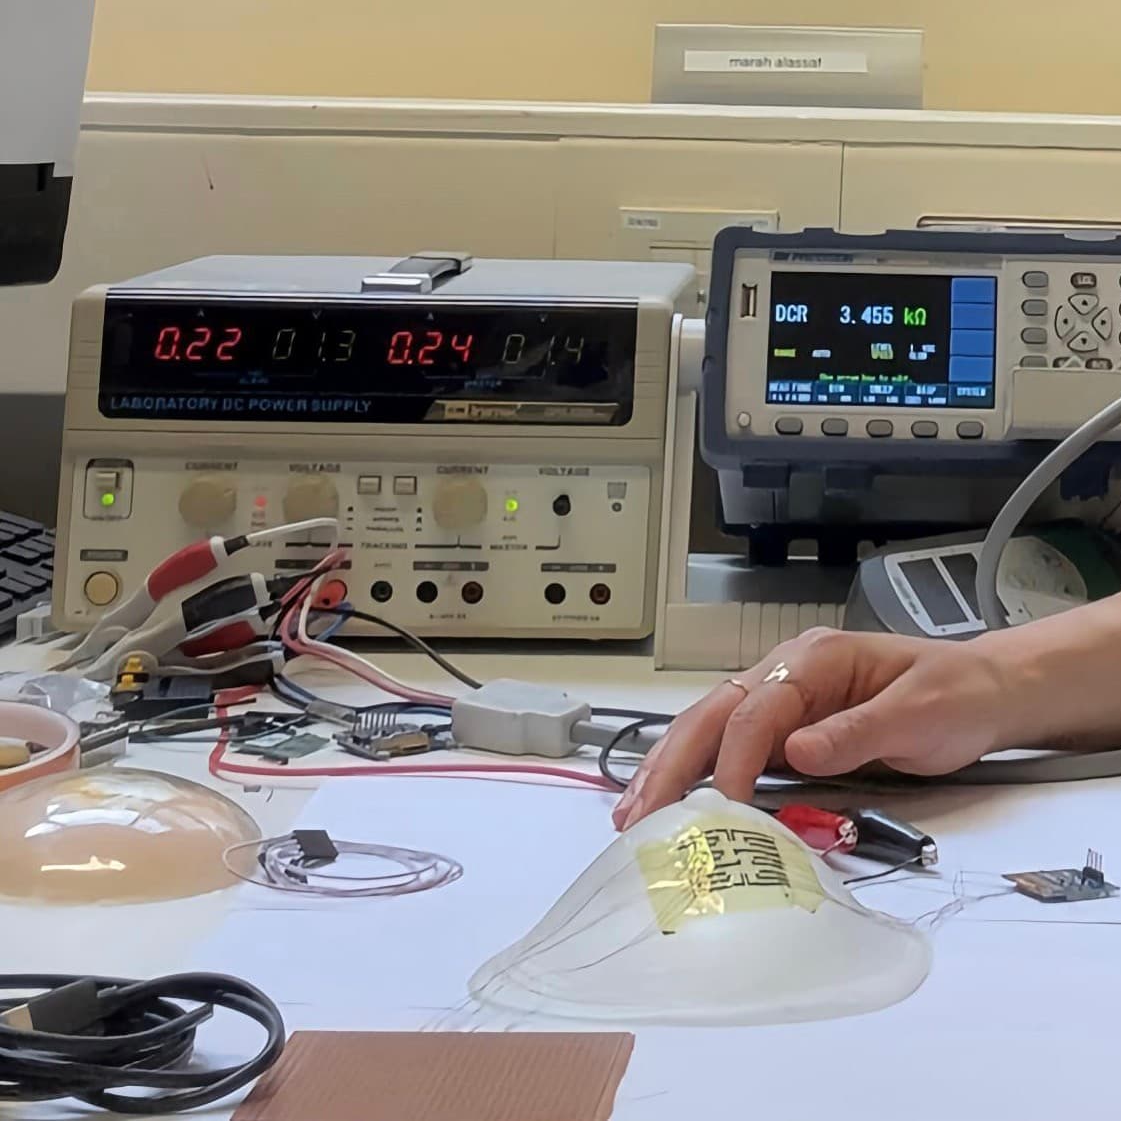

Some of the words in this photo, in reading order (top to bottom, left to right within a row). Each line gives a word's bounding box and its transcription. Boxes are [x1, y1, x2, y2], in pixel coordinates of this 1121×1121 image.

[775, 304, 808, 323] DCR
[839, 305, 894, 325] 3.455
[154, 326, 242, 361] 0.22
[387, 331, 473, 365] 0.24
[111, 396, 217, 411] LABORATORY
[222, 398, 245, 411] DC
[249, 398, 307, 412] POWER
[311, 399, 372, 413] SUPPLY
